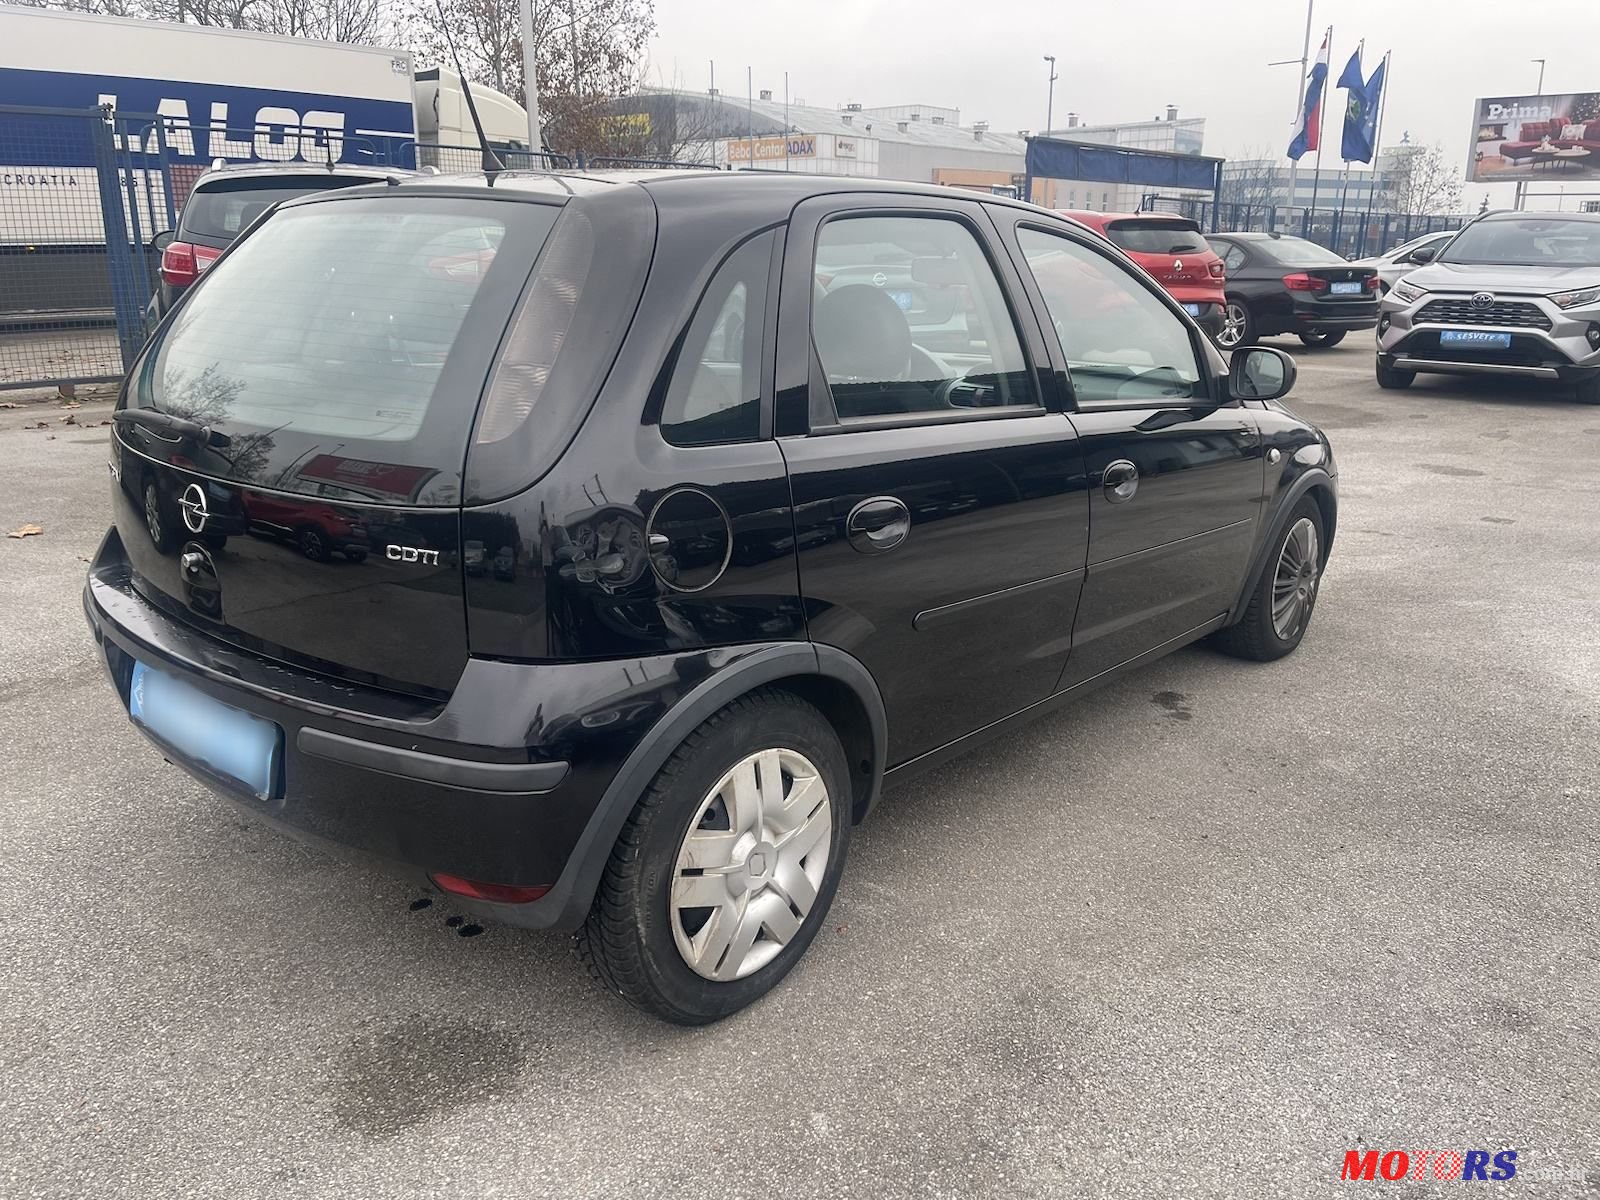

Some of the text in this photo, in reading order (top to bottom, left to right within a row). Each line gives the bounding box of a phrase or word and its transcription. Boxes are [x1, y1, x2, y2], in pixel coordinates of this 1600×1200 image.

[1487, 103, 1553, 120] Prima
[754, 142, 785, 157] Centar
[787, 140, 814, 155] ADAX
[4, 174, 77, 186] CROATIA
[386, 544, 440, 566] CDTI
